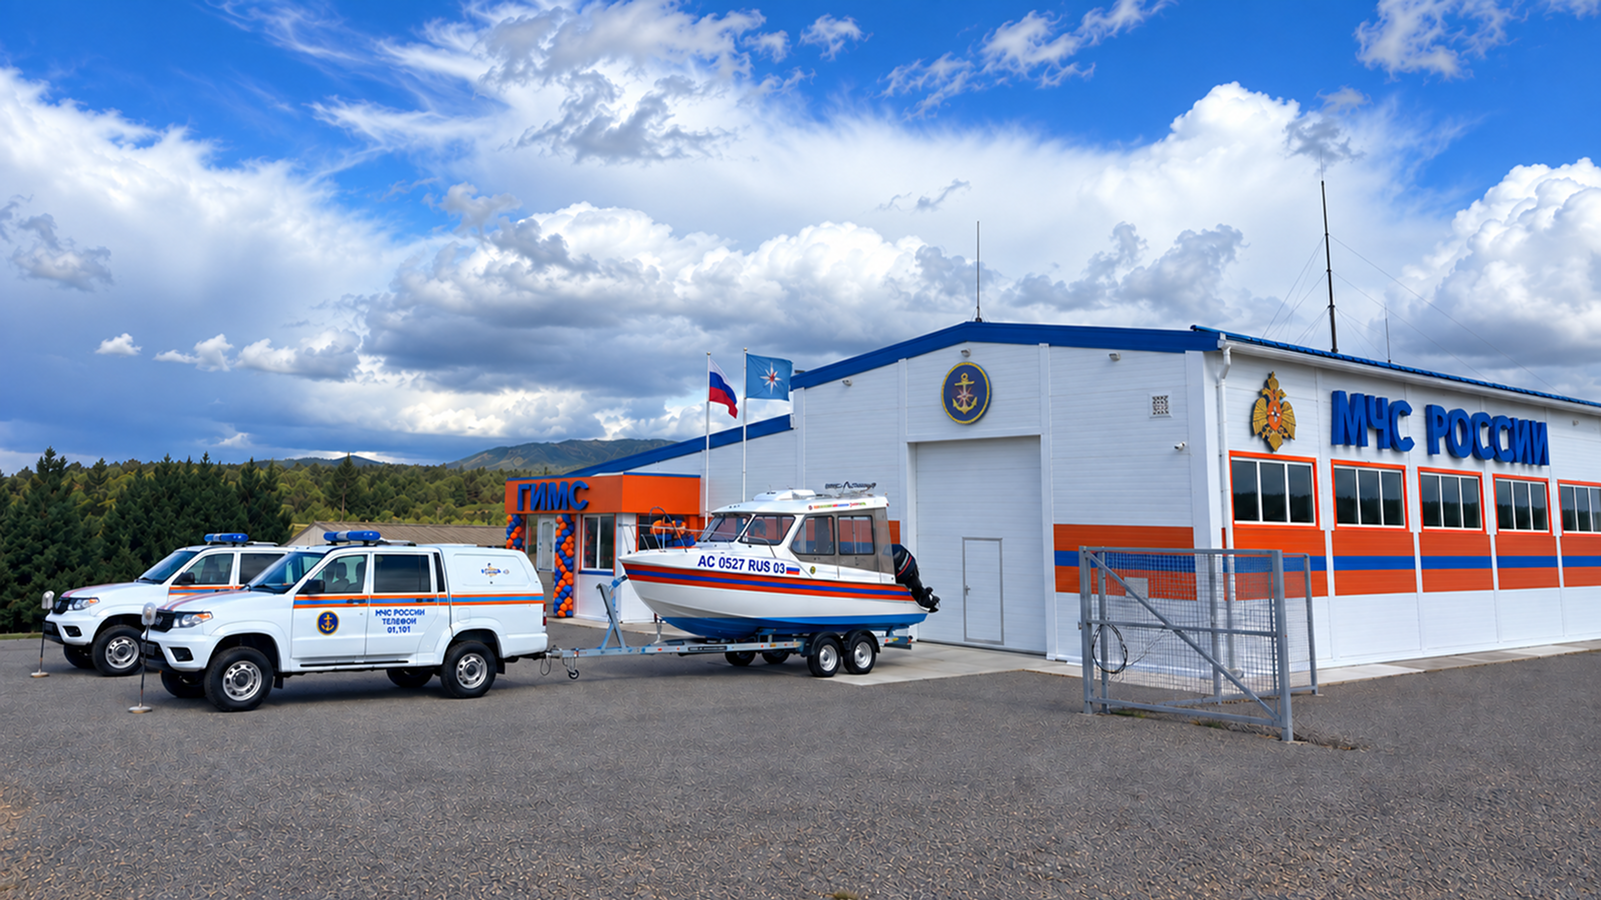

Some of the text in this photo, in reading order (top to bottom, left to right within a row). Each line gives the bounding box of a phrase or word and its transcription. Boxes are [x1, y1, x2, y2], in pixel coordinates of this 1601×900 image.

[1331, 390, 1550, 466] МЧС РОССИИ
[517, 480, 589, 511] ГИМС
[718, 556, 745, 571] 0527
[748, 559, 771, 573] RUS
[773, 562, 785, 574] 03
